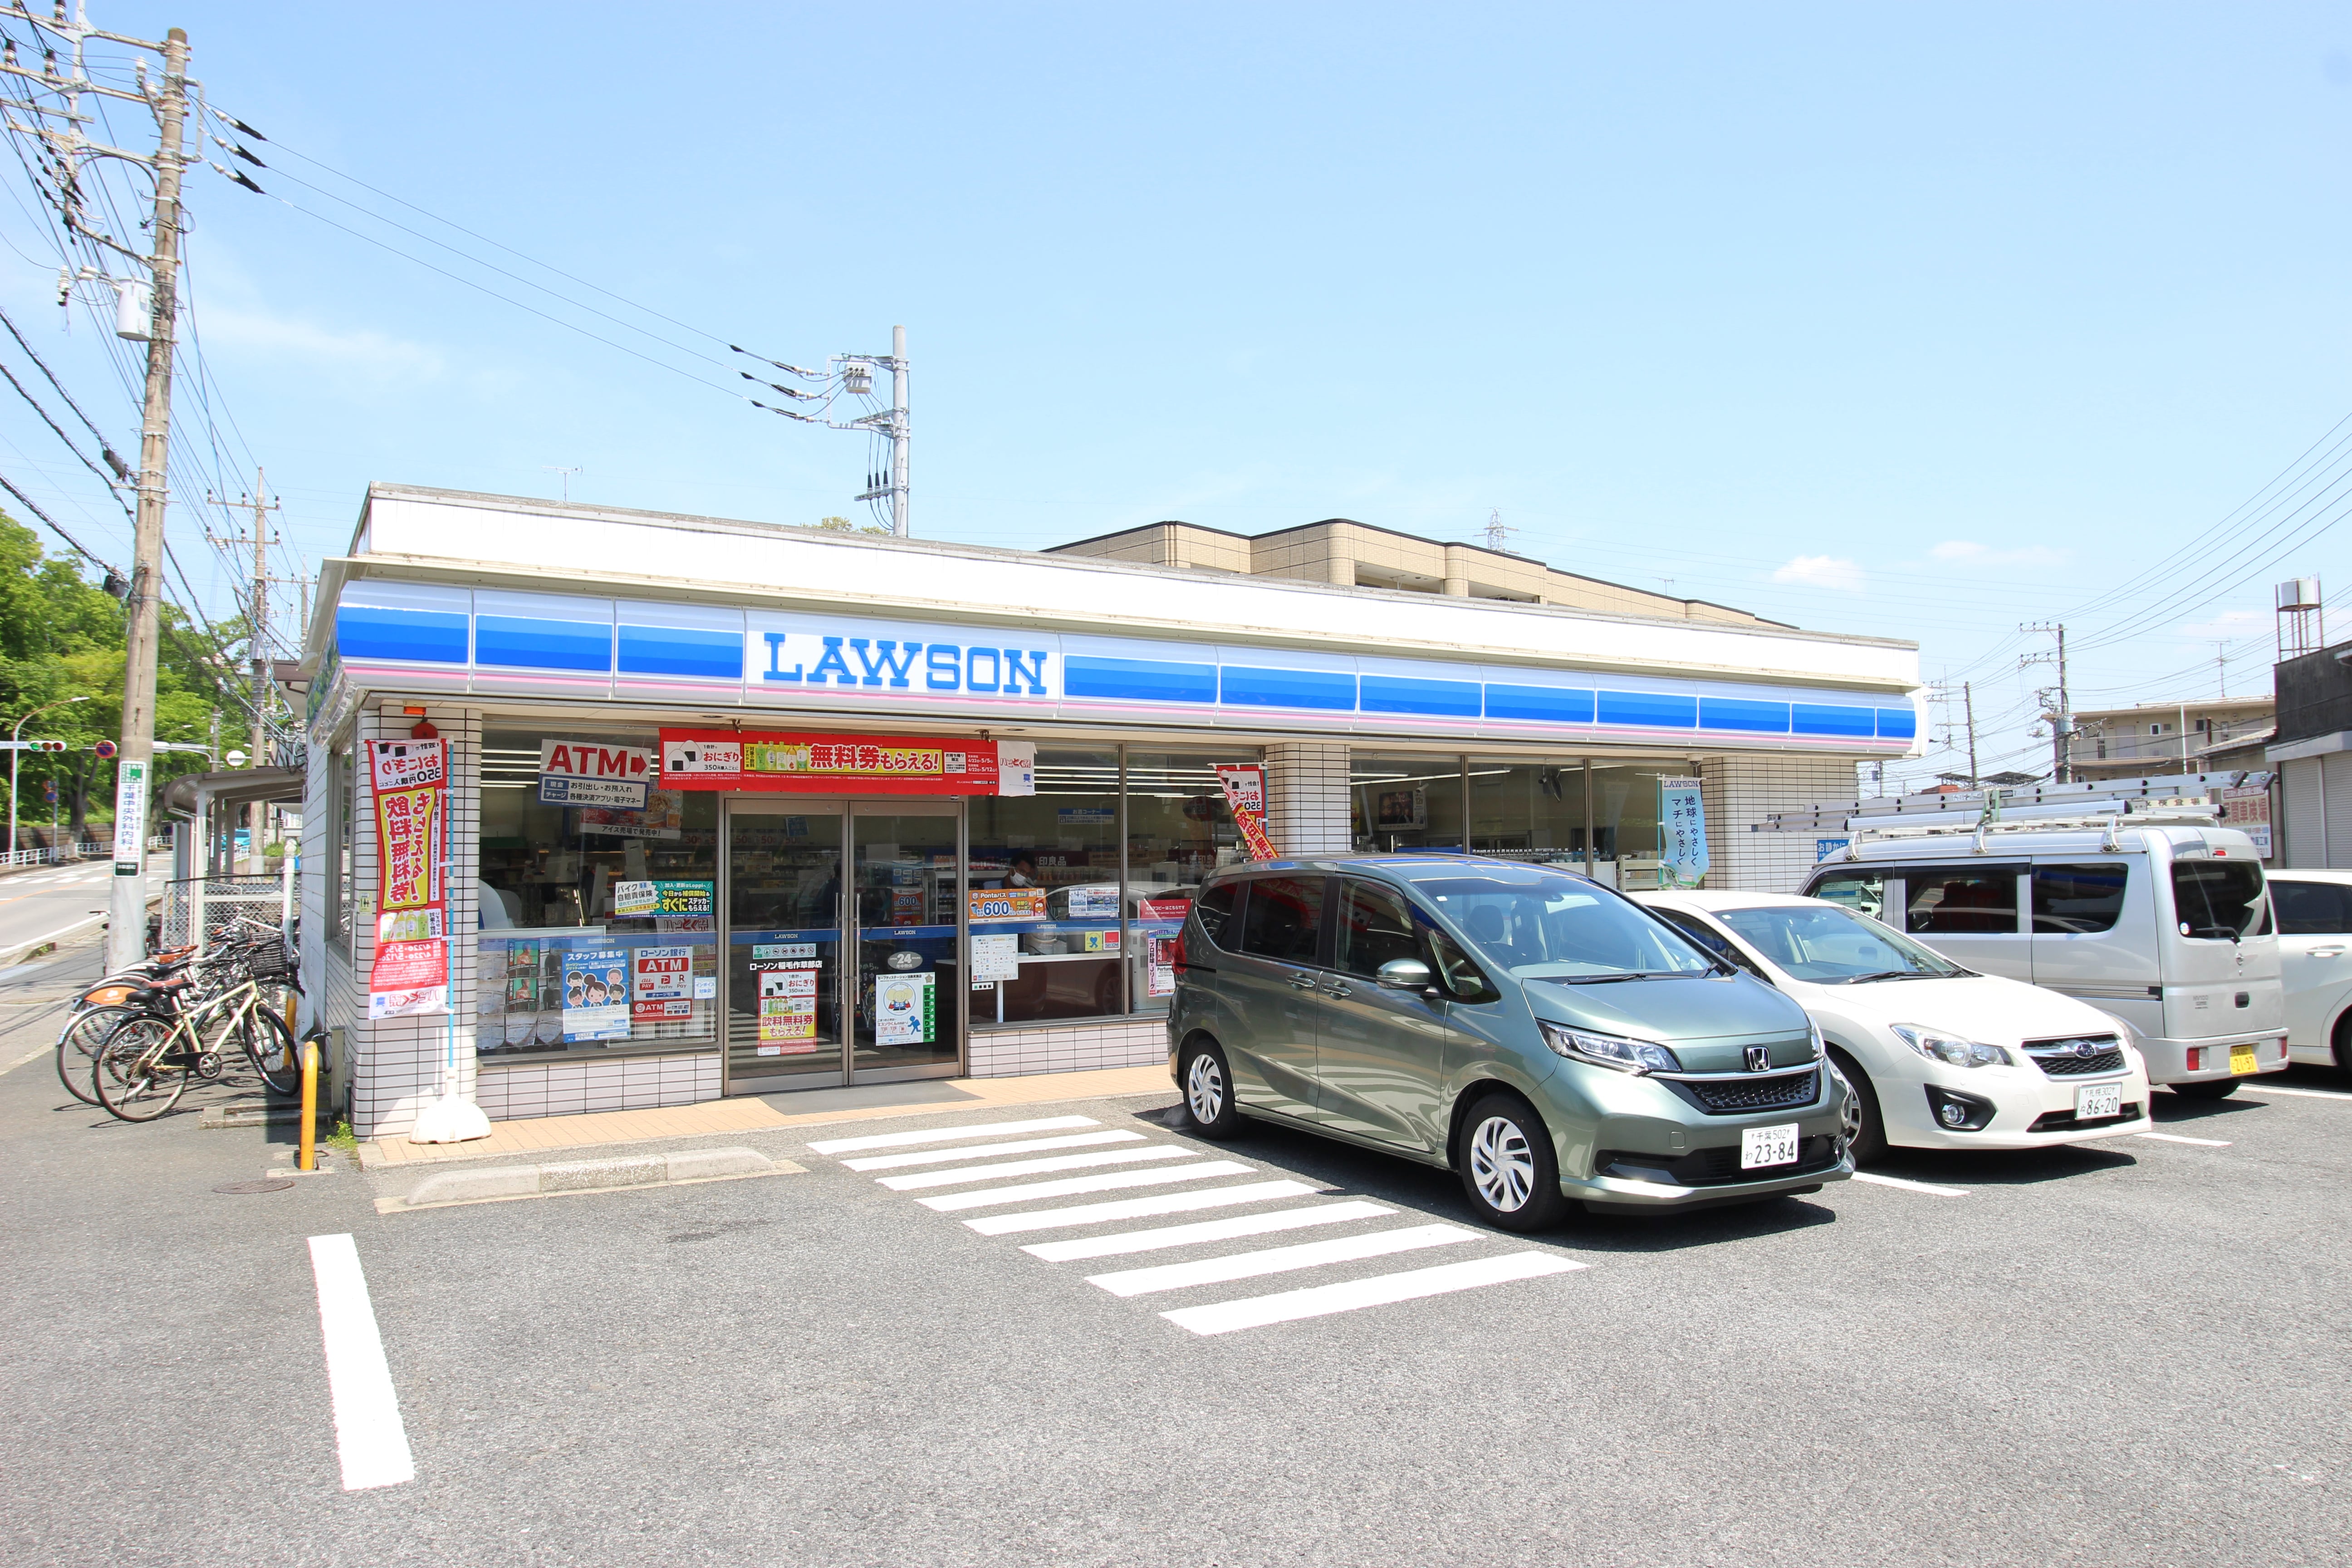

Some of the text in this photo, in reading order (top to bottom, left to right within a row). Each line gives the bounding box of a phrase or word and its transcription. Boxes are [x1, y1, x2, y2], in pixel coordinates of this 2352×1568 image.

[763, 632, 1047, 695] LAWSON
[546, 745, 627, 777] ATM
[704, 752, 739, 762] おにぎり
[810, 744, 939, 770] 無料券もらえる!
[1000, 758, 1031, 768] ハピとく祭
[571, 783, 632, 793] お引出し・お預入れ
[570, 793, 641, 804] 各種決済アプリ・電子マネー
[121, 784, 136, 846] 千葉中央外科内科
[602, 826, 661, 836] アイス売場で発売中!
[1672, 799, 1686, 866] マチにやさしく
[1685, 795, 1699, 866] 地球にやさしく
[617, 884, 637, 893] バイク
[617, 890, 653, 902] 自賠責保険
[618, 898, 654, 906] 切れていませんか?
[899, 897, 917, 906] 600
[662, 898, 687, 912] すぐに
[984, 902, 1009, 915] 600
[664, 918, 708, 932] ハピとく祭
[568, 951, 623, 961] スタッフ募集中
[641, 949, 686, 957] ローソン銀行
[897, 953, 912, 964] 24
[646, 959, 682, 972] ATM
[750, 960, 823, 971] ローソン稲毛作草部店
[789, 979, 814, 987] おにぎり
[762, 1014, 813, 1027] 飲料無料券
[769, 1025, 805, 1037] もらえる!
[2089, 1087, 2112, 1097] 札幌 302
[2087, 1097, 2117, 1115] 86-20
[1756, 1128, 1787, 1141] 千葉 502
[1745, 1151, 1753, 1161] わ
[1754, 1140, 1794, 1164] 23-84
